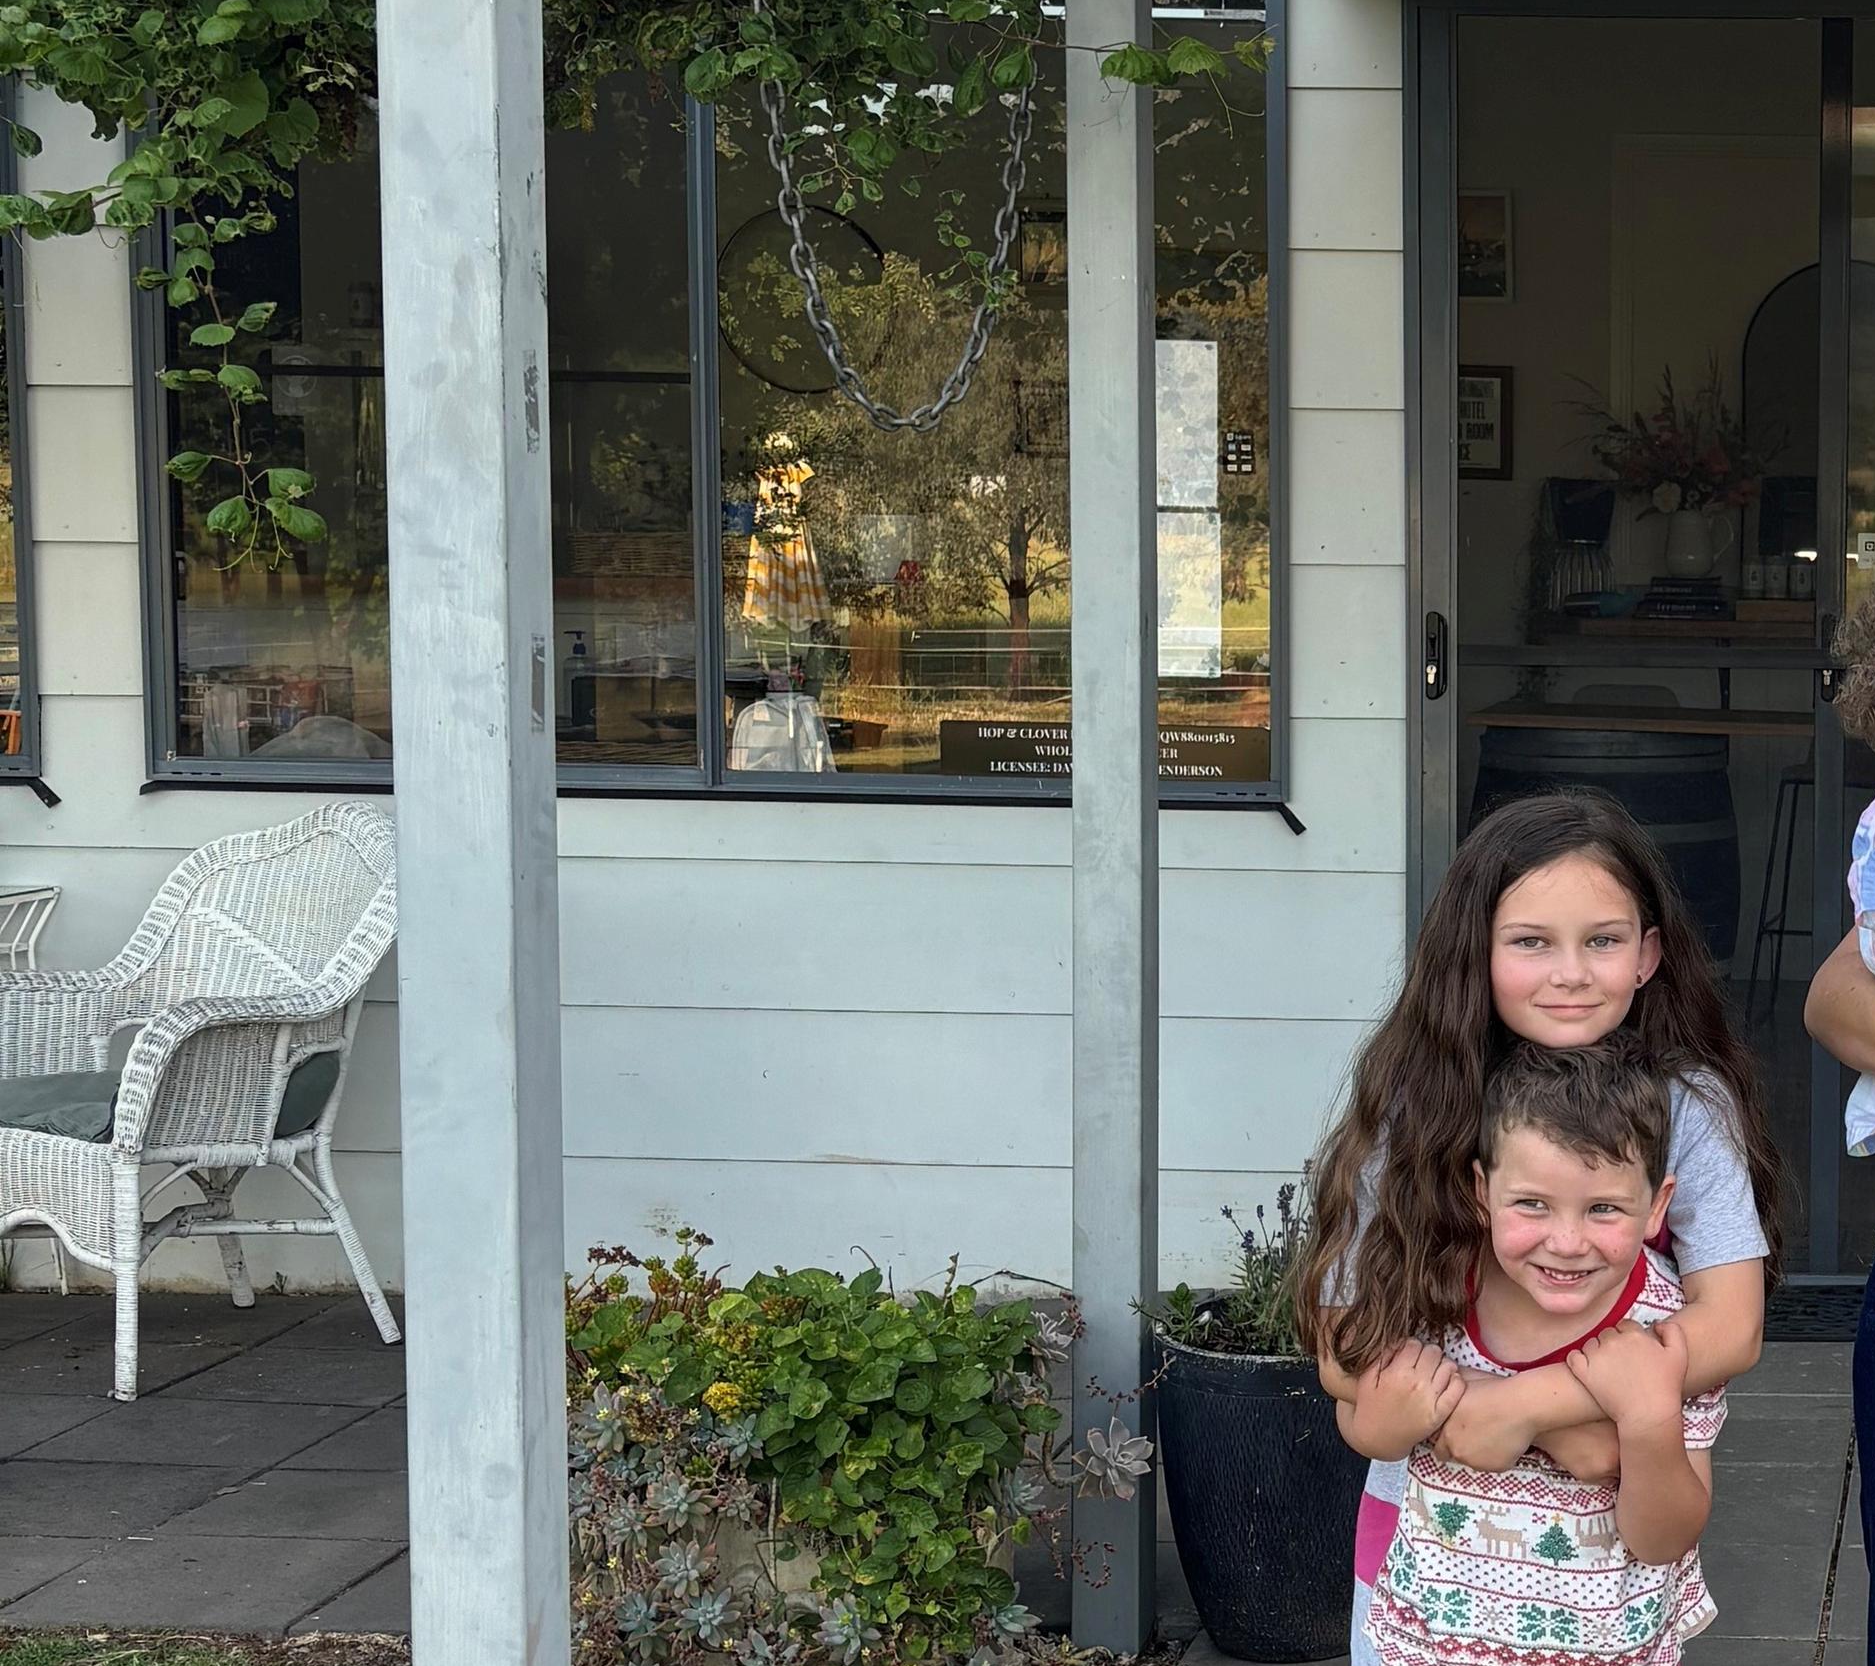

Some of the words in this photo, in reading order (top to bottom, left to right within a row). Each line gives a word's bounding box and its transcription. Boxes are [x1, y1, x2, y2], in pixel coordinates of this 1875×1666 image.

[978, 727, 1004, 738] HOP
[1006, 728, 1016, 739] &
[1020, 728, 1068, 740] CLOVER
[1035, 745, 1073, 757] WHOL
[990, 761, 1051, 773] LICENSEE:
[1158, 765, 1223, 776] ENDERSON
